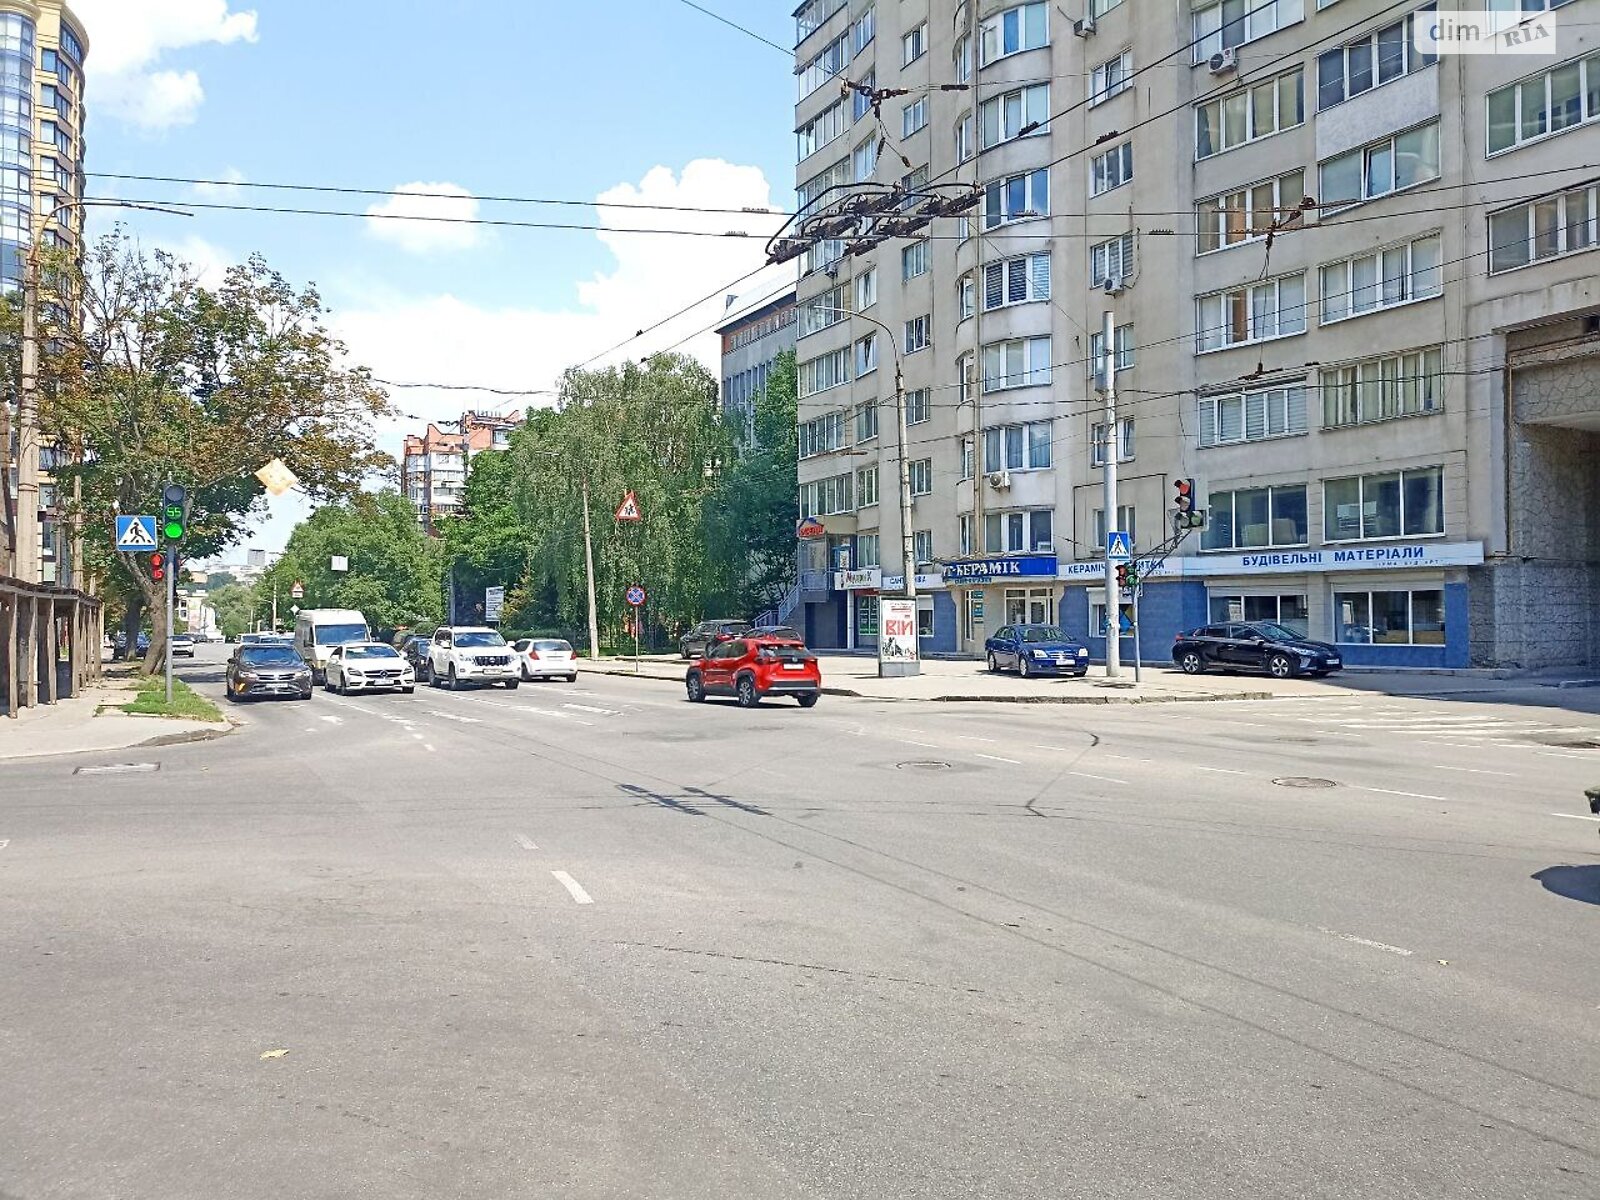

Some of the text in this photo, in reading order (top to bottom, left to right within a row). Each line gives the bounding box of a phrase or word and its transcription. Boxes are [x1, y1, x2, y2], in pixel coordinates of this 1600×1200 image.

[166, 506, 182, 517] 55
[1242, 546, 1424, 567] БУДІВЕЛЬНІ МАТЕРІАЛИ
